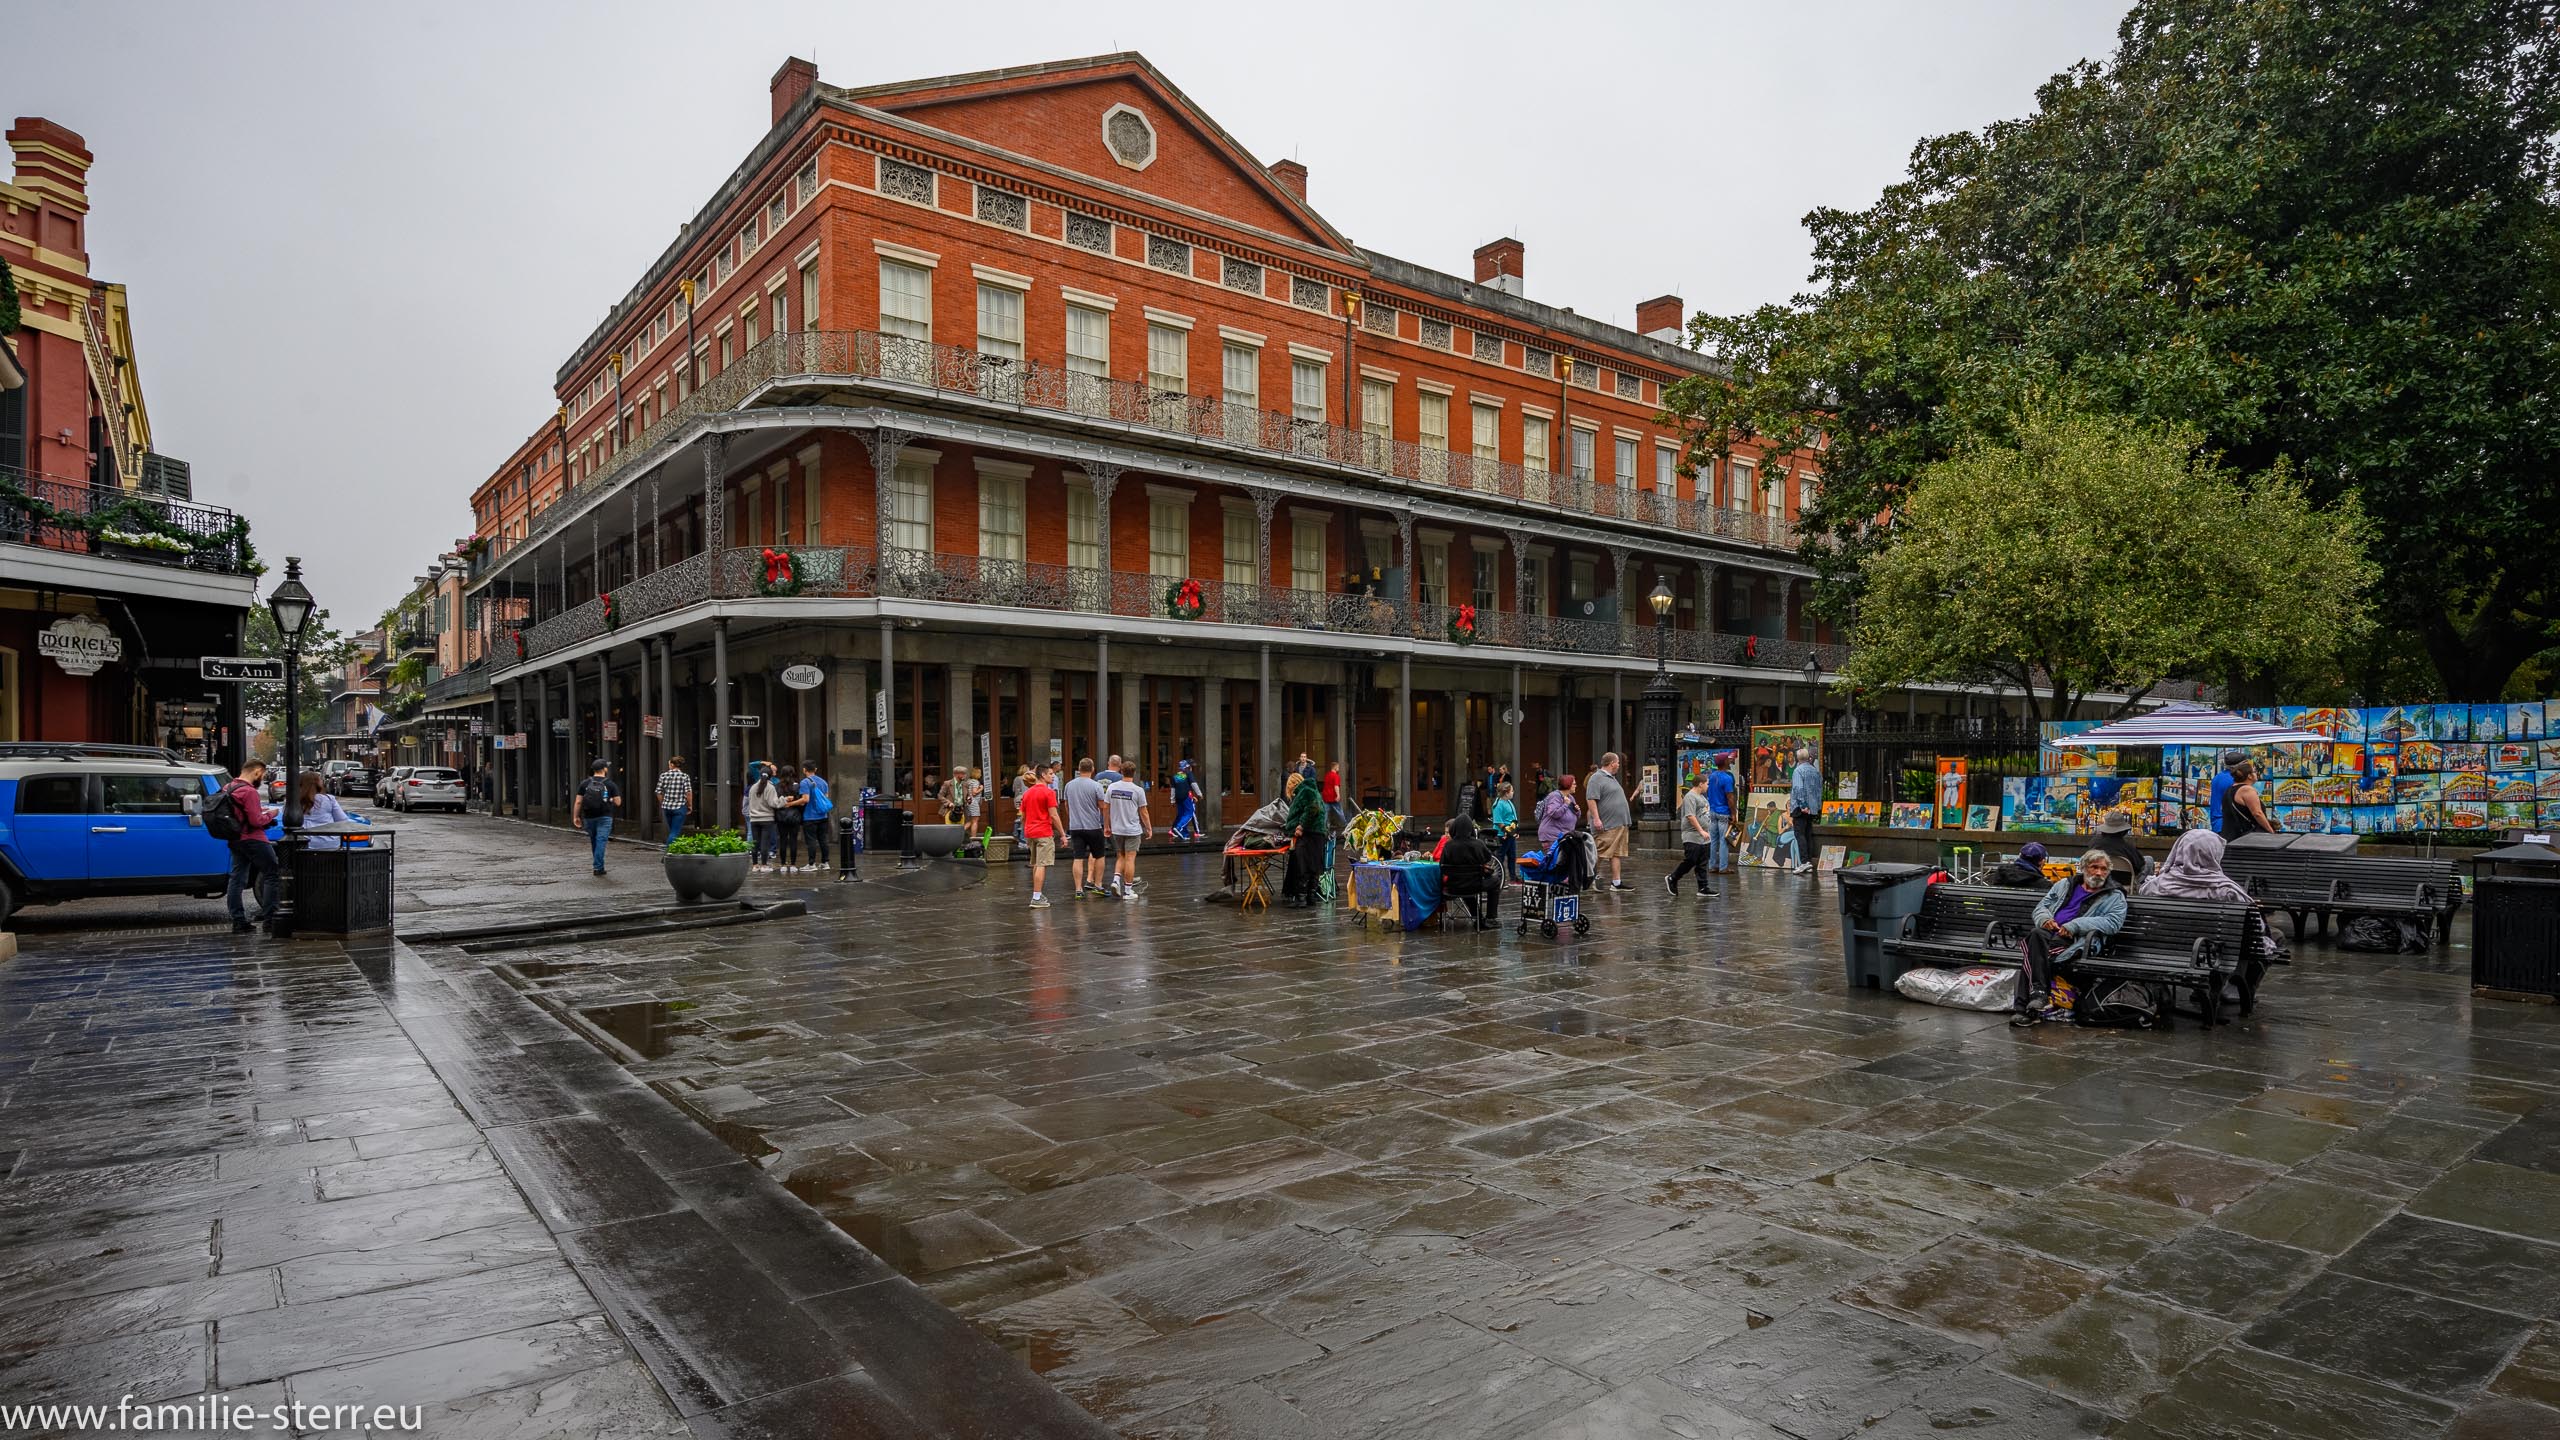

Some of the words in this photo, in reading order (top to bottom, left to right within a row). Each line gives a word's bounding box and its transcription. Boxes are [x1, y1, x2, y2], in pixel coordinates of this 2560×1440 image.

[41, 634, 120, 658] MURIEL'S
[212, 664, 232, 676] St.
[240, 666, 273, 677] Ann
